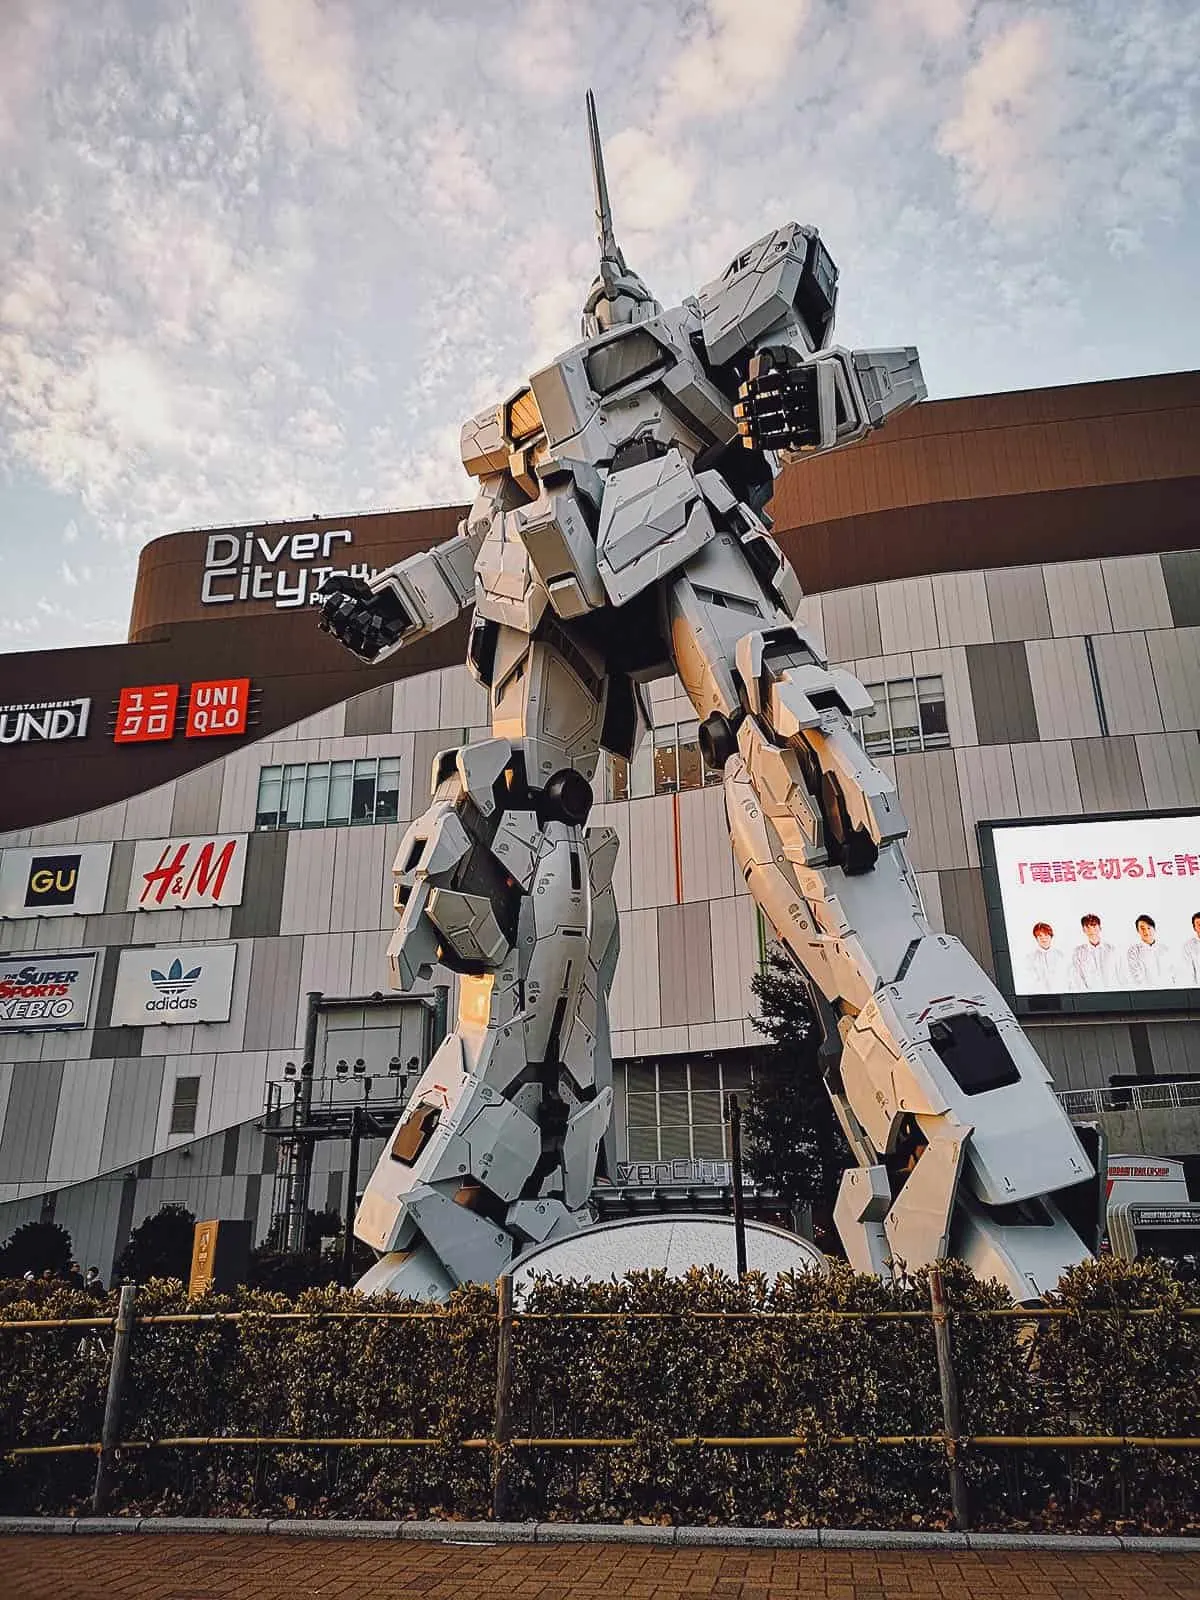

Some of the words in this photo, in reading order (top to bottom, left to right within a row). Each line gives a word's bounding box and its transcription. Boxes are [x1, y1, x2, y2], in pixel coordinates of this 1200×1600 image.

[205, 530, 352, 568] Diver
[201, 565, 308, 608] City
[196, 687, 239, 707] UNI
[193, 708, 239, 732] QLO
[31, 869, 76, 893] GU
[140, 839, 237, 904] H&M
[15, 966, 79, 985] SUPER
[0, 980, 70, 998] SPORTS
[0, 998, 74, 1020] XEBIO
[146, 997, 198, 1011] adidas
